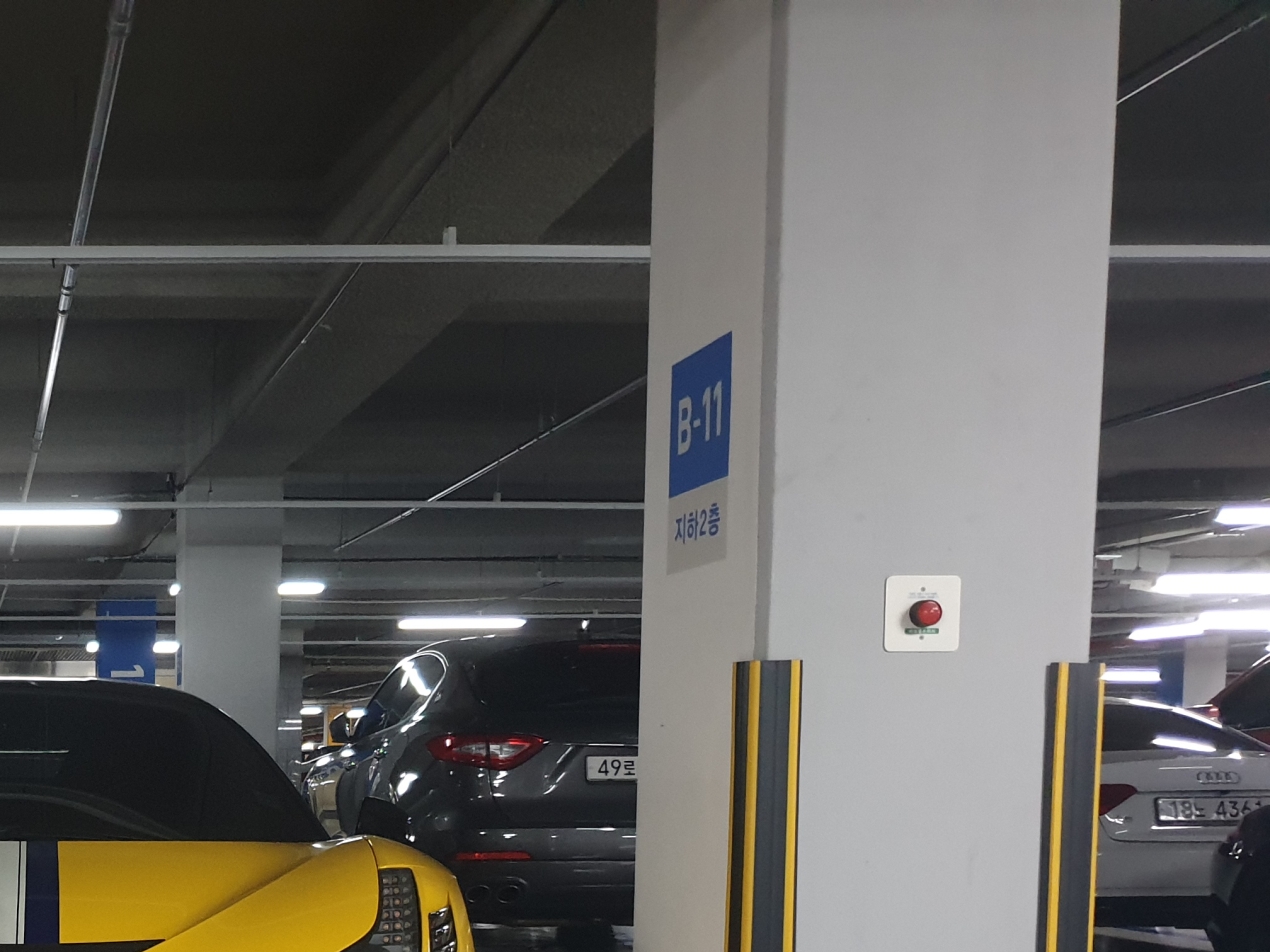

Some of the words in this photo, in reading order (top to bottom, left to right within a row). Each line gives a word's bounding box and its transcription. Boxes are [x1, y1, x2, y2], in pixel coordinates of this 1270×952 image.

[677, 379, 723, 456] B-11
[674, 502, 721, 544] 지하2층
[597, 759, 636, 776] 49로
[1215, 800, 1262, 819] 436
